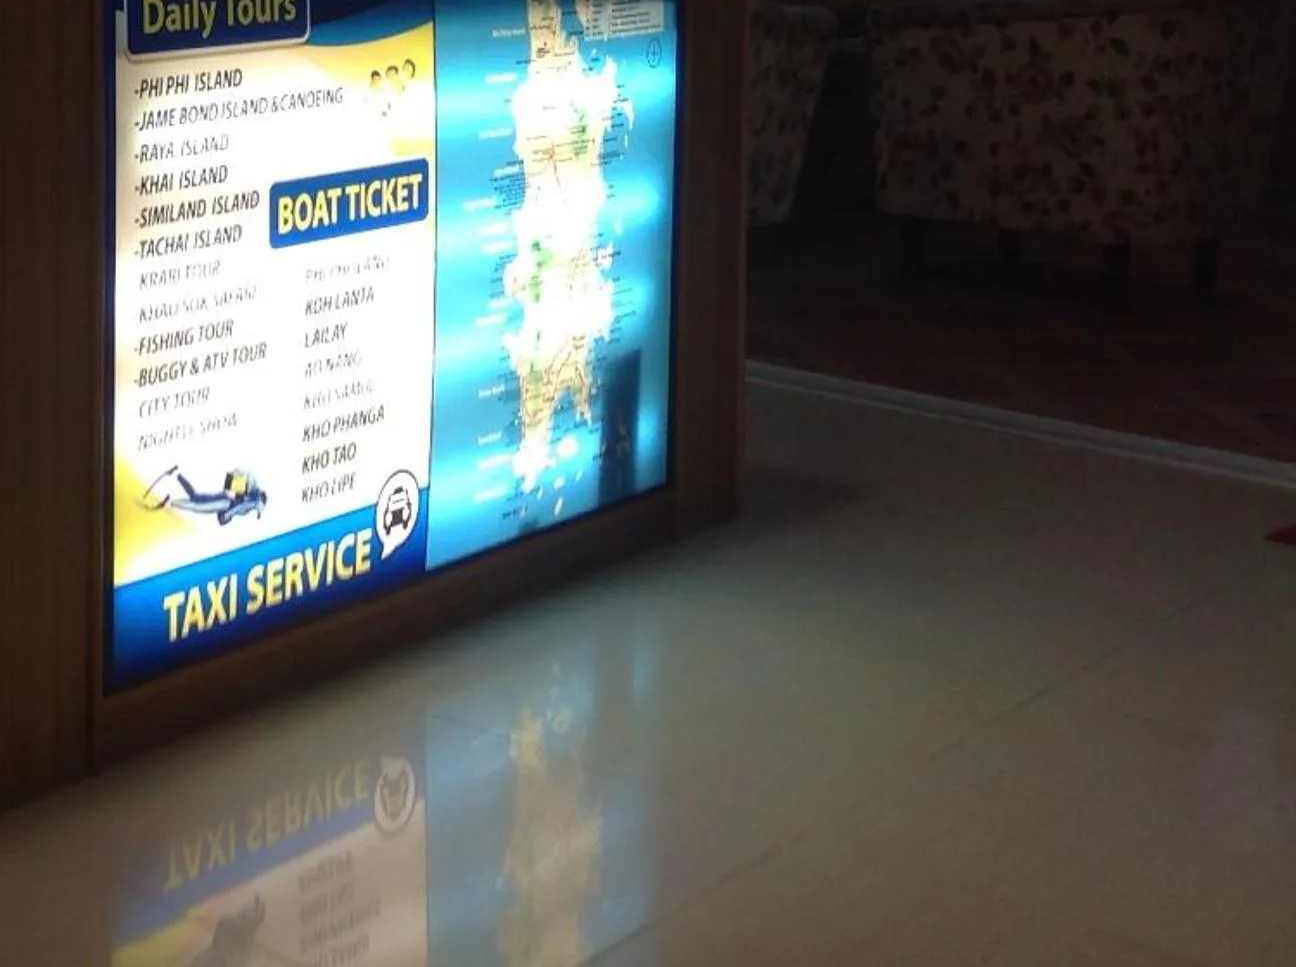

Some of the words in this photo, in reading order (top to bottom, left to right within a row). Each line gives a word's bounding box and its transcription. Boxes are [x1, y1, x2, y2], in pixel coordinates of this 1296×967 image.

[165, 72, 190, 96] PHI
[194, 68, 244, 93] ISLAND
[179, 102, 218, 125] BOND
[221, 97, 268, 120] ISLAND
[178, 165, 229, 189] ISLAND
[211, 191, 260, 216] ISLAND
[278, 189, 341, 236] BOAT
[342, 173, 423, 221] TICKET
[193, 225, 243, 250] ISLAND
[335, 285, 375, 311] LANTA
[197, 319, 235, 344] TOUR
[189, 356, 200, 376] &
[202, 351, 230, 374] ATV
[231, 341, 268, 366] TOUR
[302, 418, 331, 443] KHO
[302, 448, 331, 475] KHO
[333, 440, 358, 466] TAO
[302, 479, 330, 504] KHO
[163, 576, 238, 644] TAXI
[245, 527, 373, 616] SERVICE
